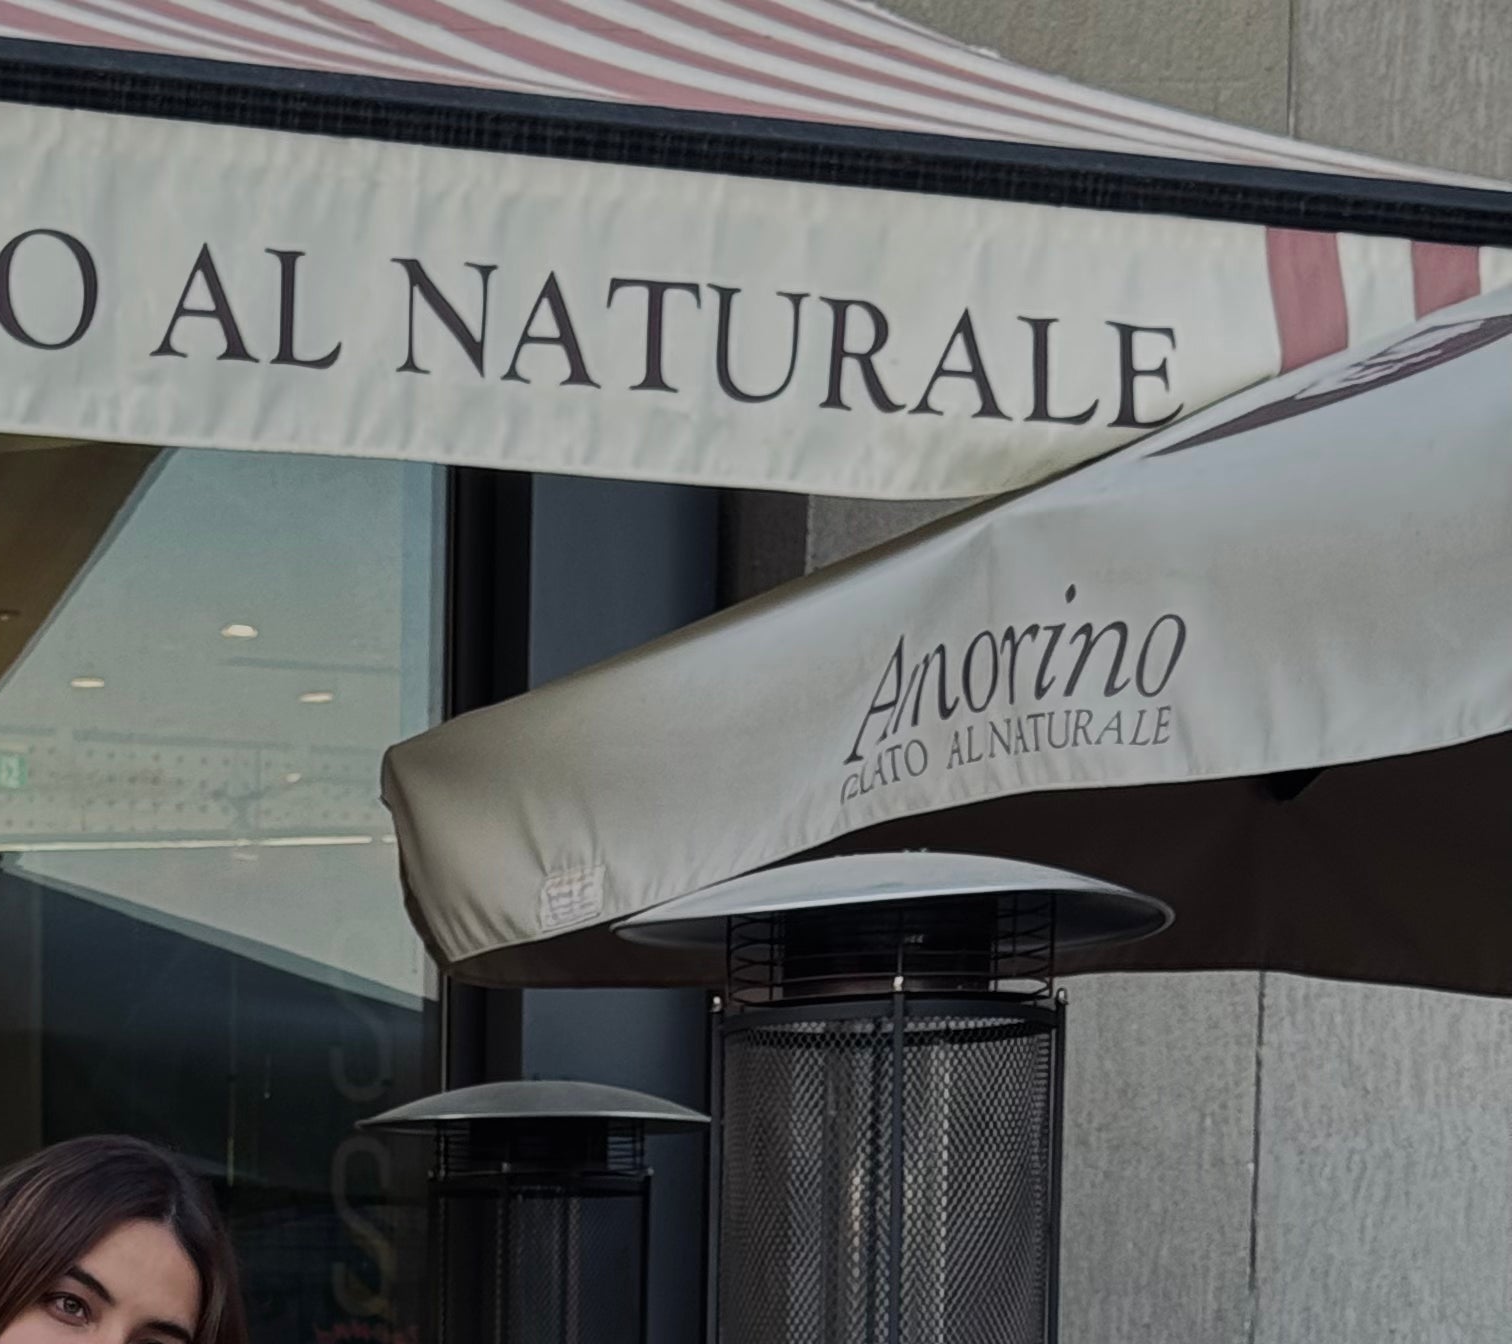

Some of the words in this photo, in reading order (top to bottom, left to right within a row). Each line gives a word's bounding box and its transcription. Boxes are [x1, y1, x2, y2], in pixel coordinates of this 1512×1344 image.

[148, 242, 344, 371] AL
[391, 257, 1185, 429] NATURALE
[946, 725, 984, 770] AL
[987, 705, 1172, 760] NATURALE
